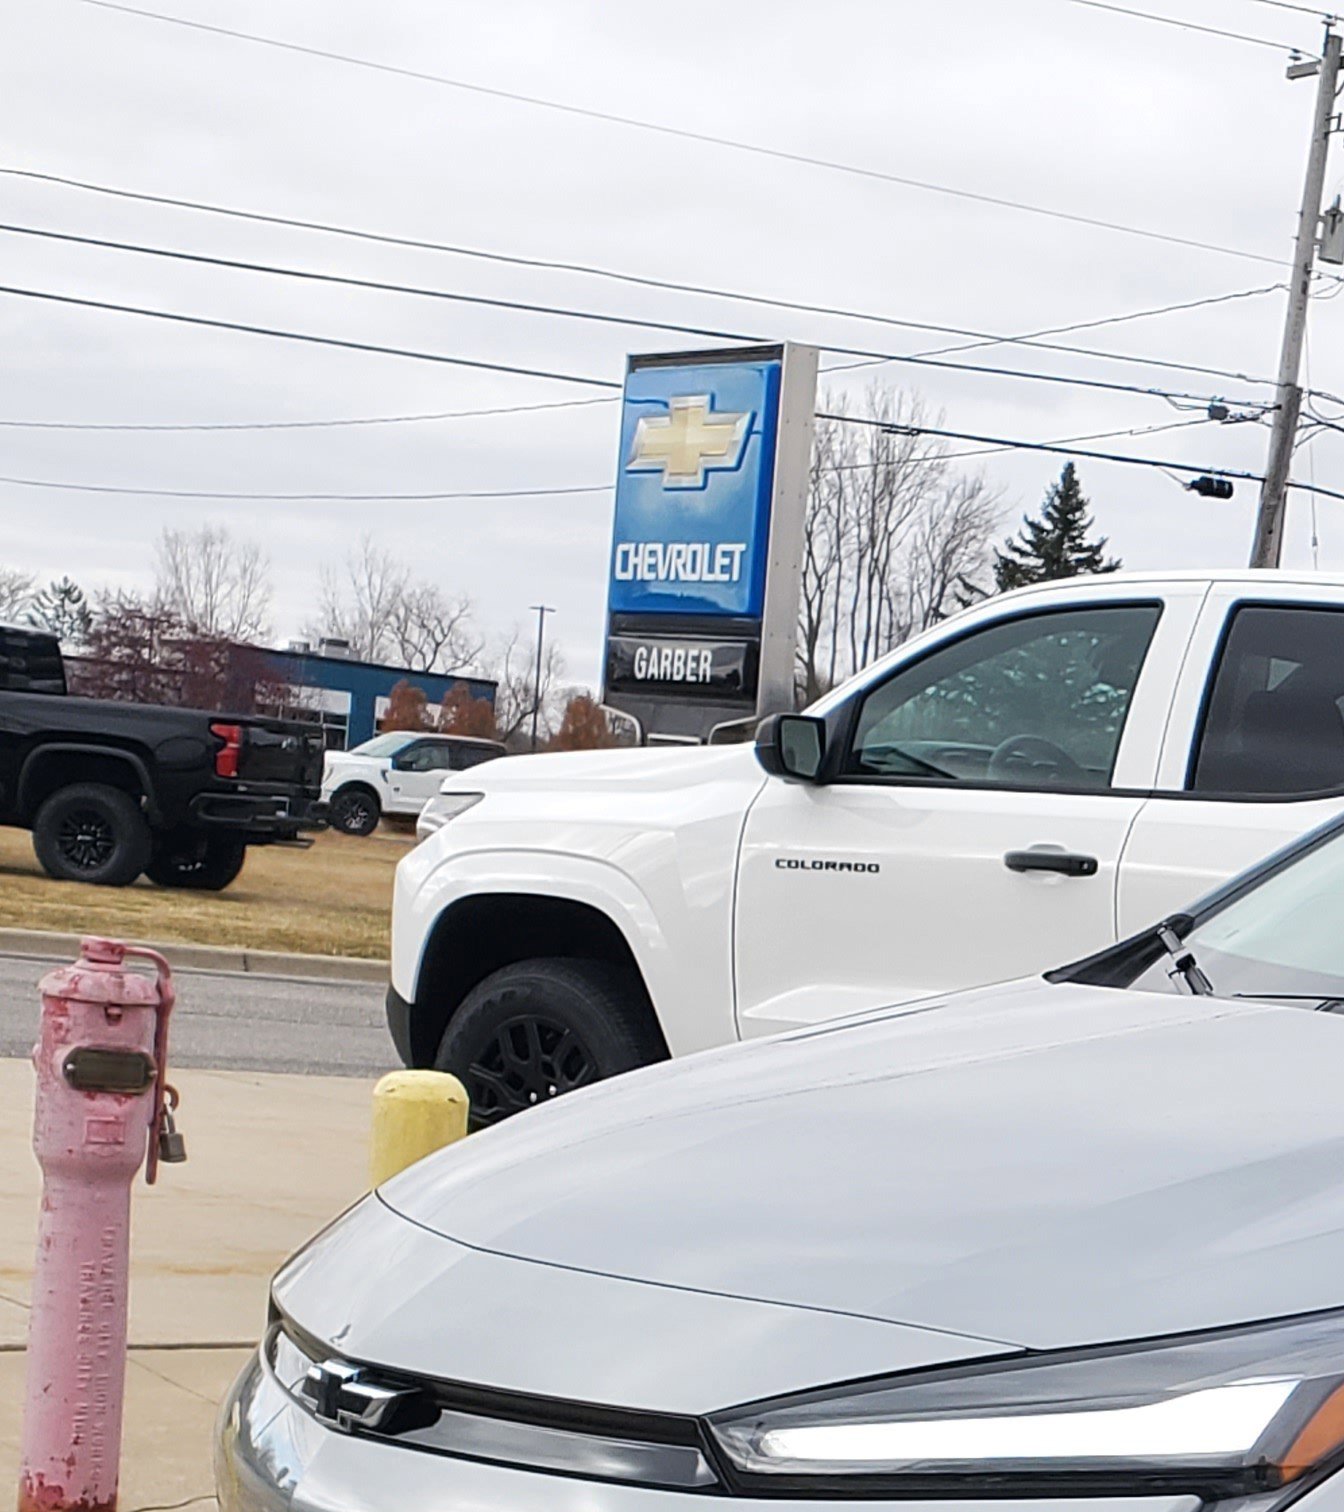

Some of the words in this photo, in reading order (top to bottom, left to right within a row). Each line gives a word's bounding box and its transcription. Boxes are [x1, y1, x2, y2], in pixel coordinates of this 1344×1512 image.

[615, 542, 747, 582] CHEVROLET
[634, 645, 713, 684] GARBER
[775, 858, 880, 873] COLORADO
[75, 1354, 92, 1392] CITY
